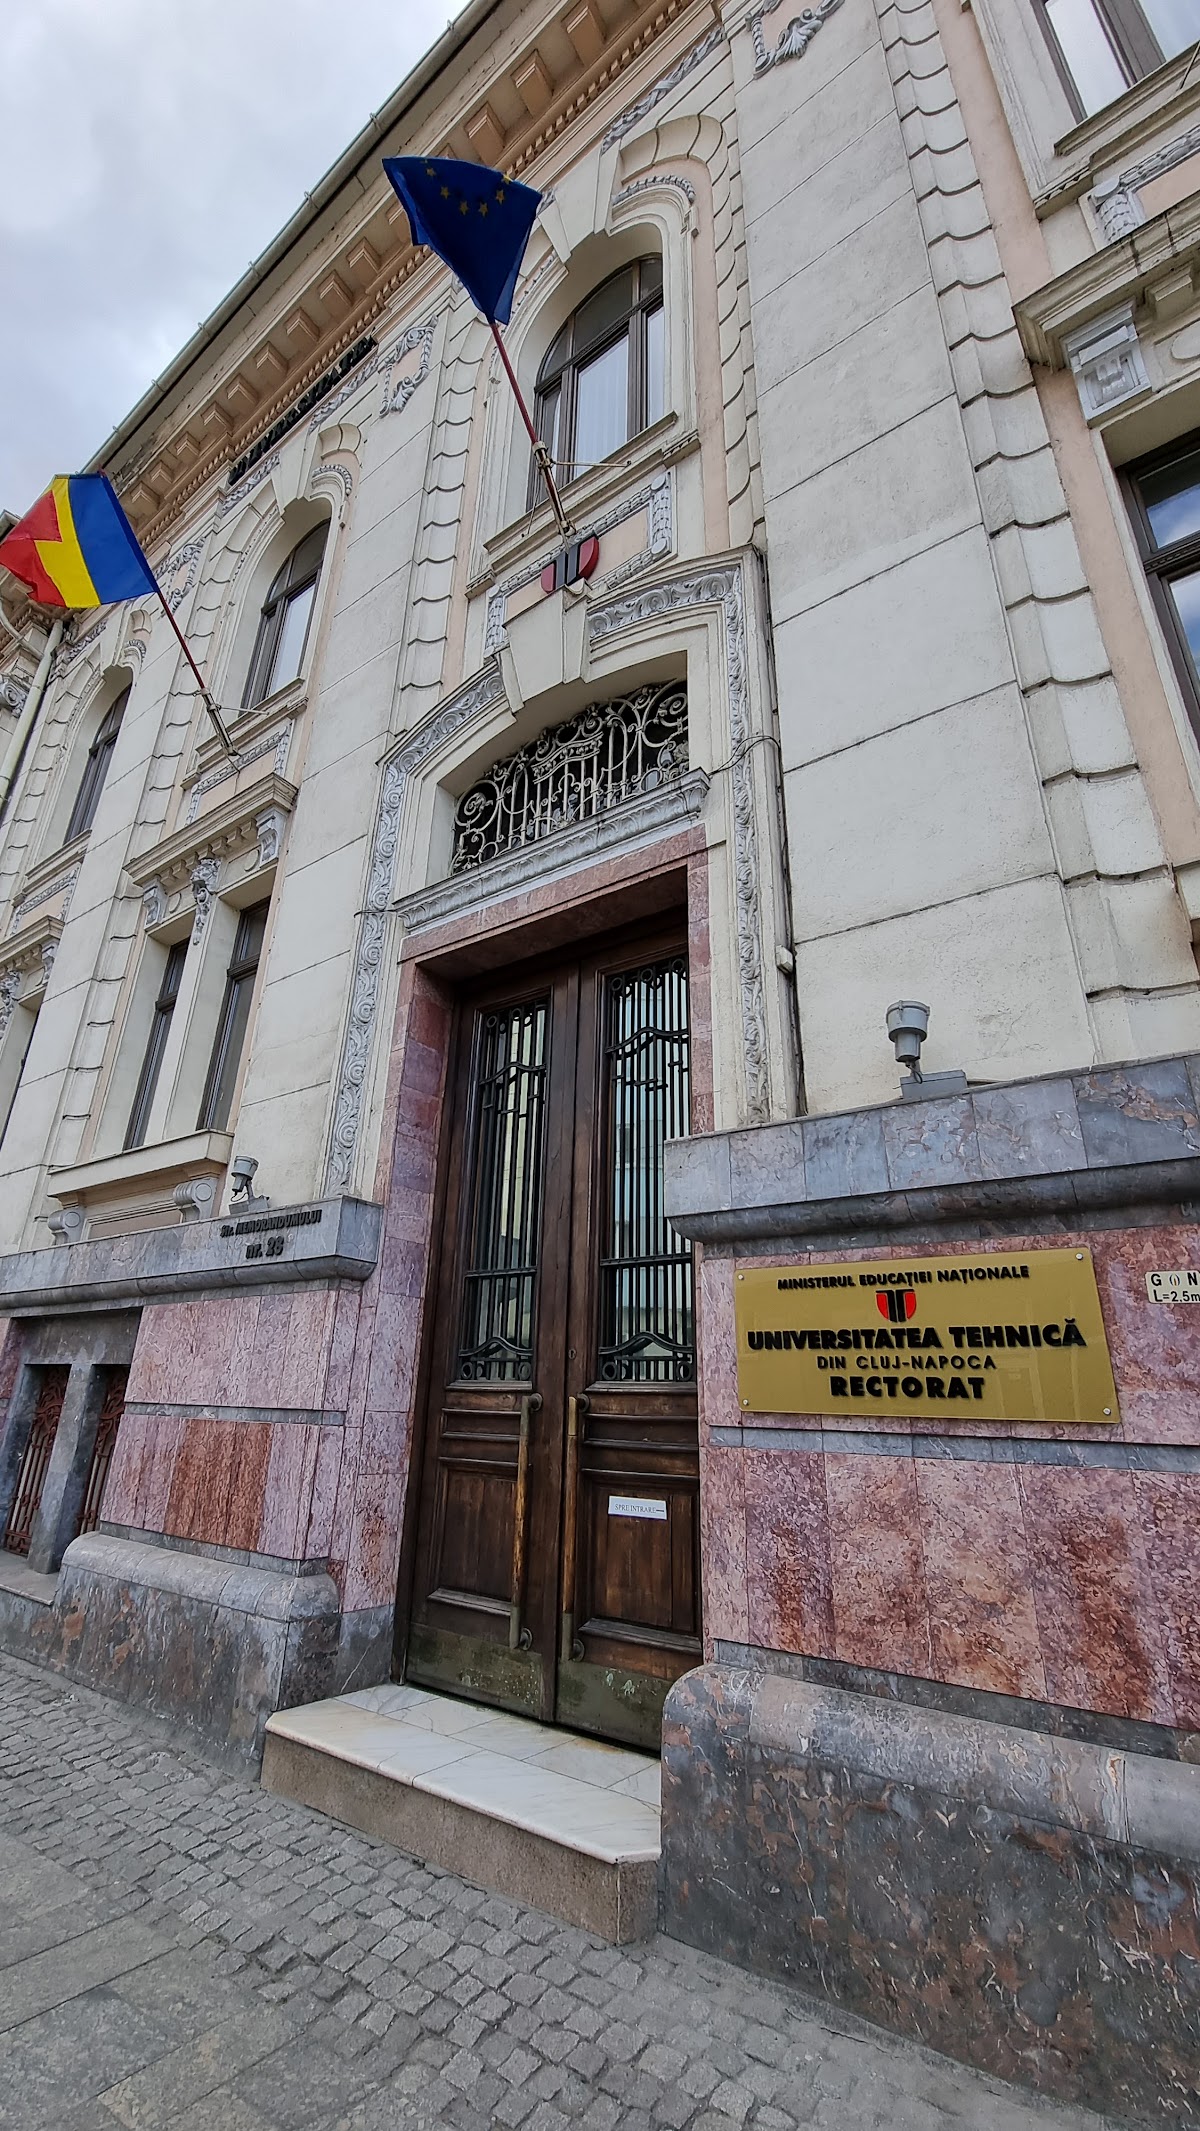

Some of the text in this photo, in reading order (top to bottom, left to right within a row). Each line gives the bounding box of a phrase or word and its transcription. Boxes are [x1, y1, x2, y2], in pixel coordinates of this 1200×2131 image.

[235, 1209, 323, 1236] MEMORANDUMULUI
[245, 1236, 284, 1259] nr. 28
[777, 1275, 857, 1290] MINISTERUL
[748, 1318, 1087, 1350] UNIVERSITATEA TEHNICĂ
[817, 1354, 996, 1370] DIN CLUJ-NAPOCA
[829, 1375, 985, 1399] RECTORAT
